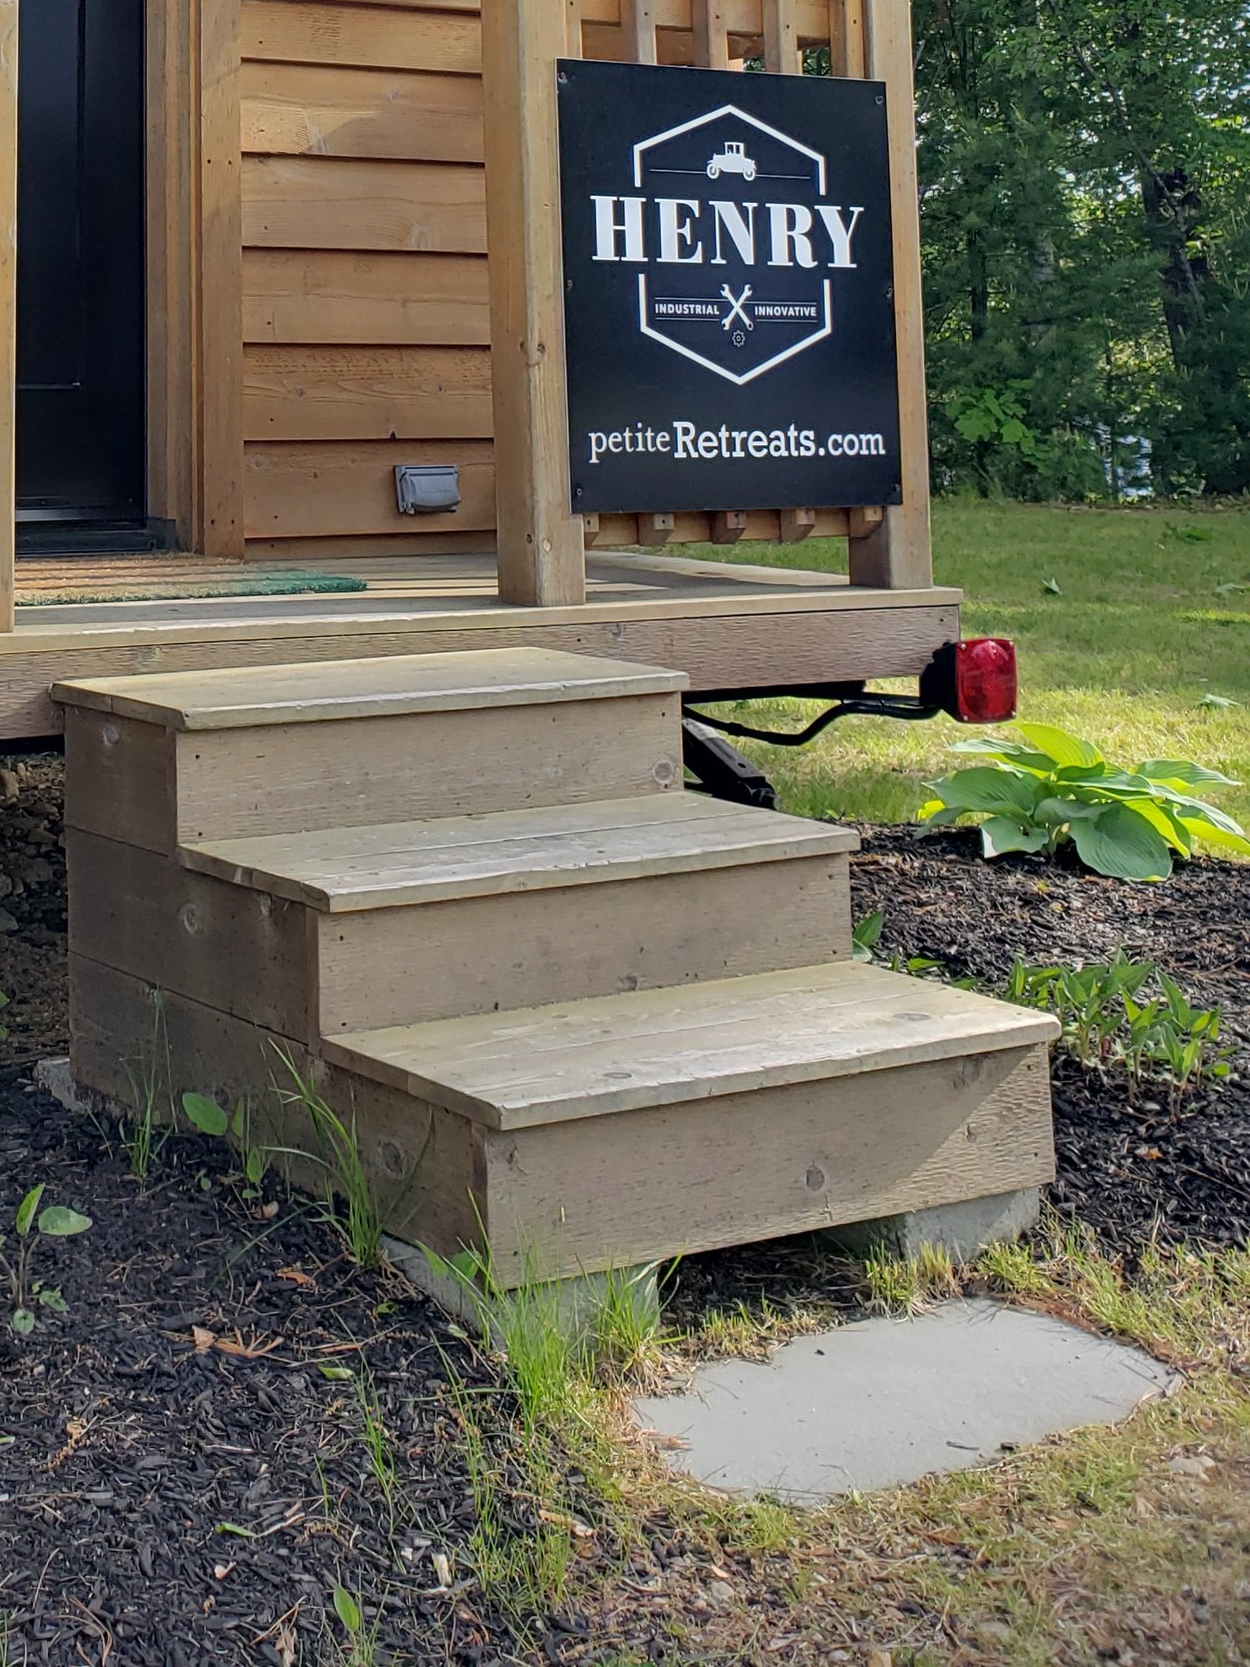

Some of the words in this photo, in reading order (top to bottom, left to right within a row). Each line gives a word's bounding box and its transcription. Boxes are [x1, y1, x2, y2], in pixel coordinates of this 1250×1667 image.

[589, 194, 865, 269] HENRY
[655, 302, 720, 315] INDUSTRIAL
[754, 305, 817, 317] INNOVATIVE
[588, 422, 885, 463] petiteRetreats.com
